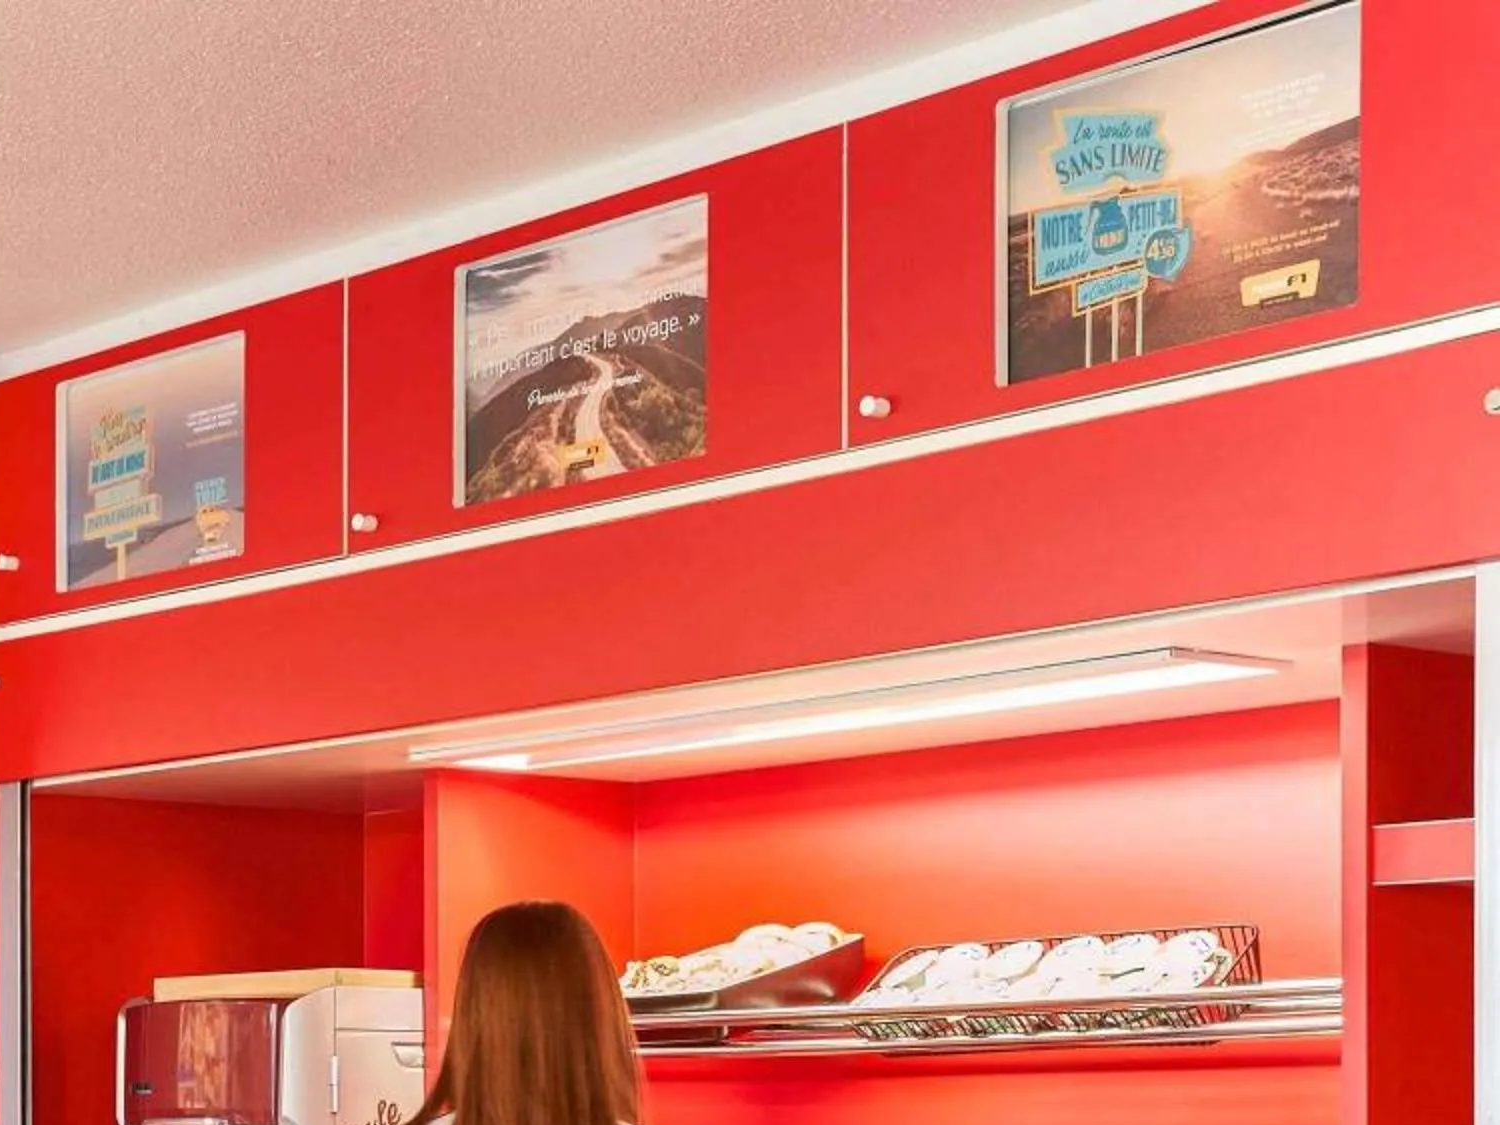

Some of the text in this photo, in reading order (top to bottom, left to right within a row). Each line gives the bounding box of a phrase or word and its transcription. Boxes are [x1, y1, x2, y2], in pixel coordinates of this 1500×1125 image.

[1055, 143, 1167, 185] SANS LIMITE
[1041, 212, 1084, 250] NOTRE
[603, 329, 617, 349] le
